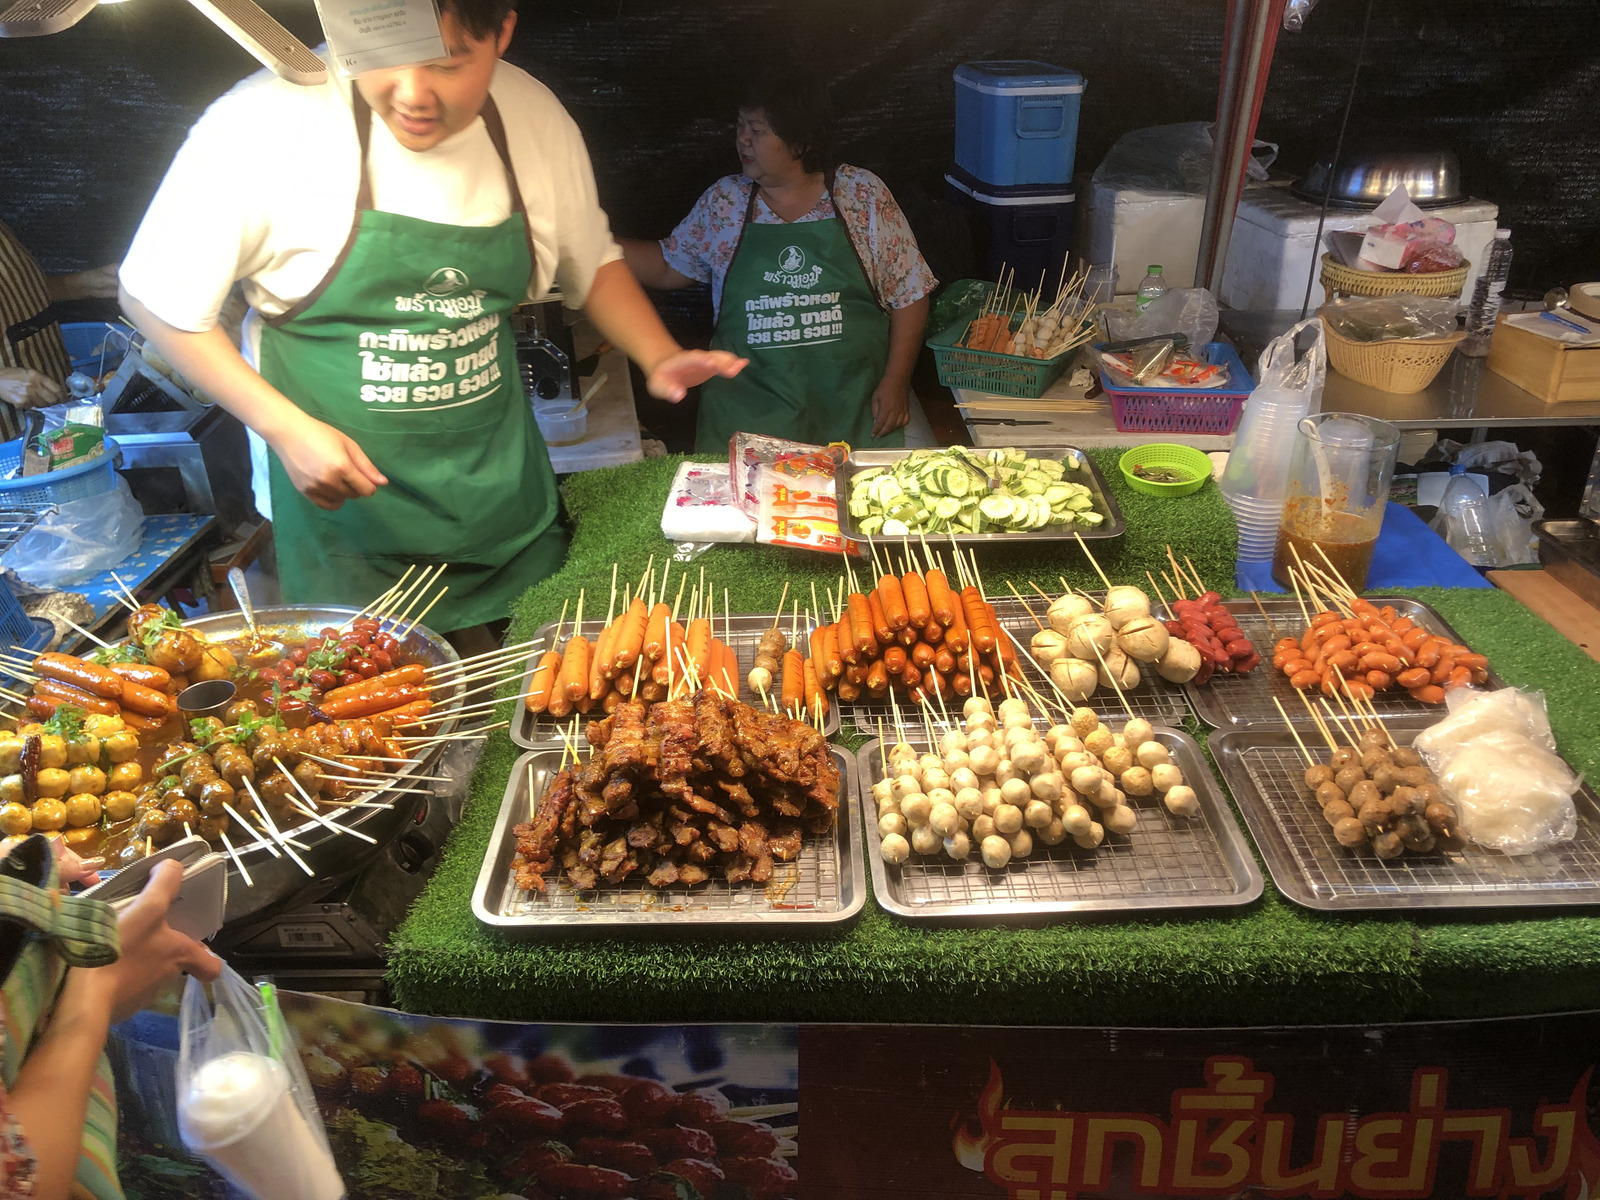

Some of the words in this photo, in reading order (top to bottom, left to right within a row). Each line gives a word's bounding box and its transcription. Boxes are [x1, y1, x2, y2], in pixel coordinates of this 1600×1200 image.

[745, 291, 840, 312] กะทิพร้าวหอม
[746, 311, 795, 331] ใช้แล้ว
[800, 304, 843, 325] ขายดี
[359, 313, 500, 351] กะทิพร้าวหอม
[747, 331, 771, 345] รวย
[773, 328, 801, 342] รวย
[358, 351, 447, 382] ใช้แล้ว
[455, 332, 500, 376] ขายดี
[360, 384, 408, 403] รวย
[412, 382, 455, 403] รวย
[988, 1058, 1578, 1200] ลกชิ้นย่าง
